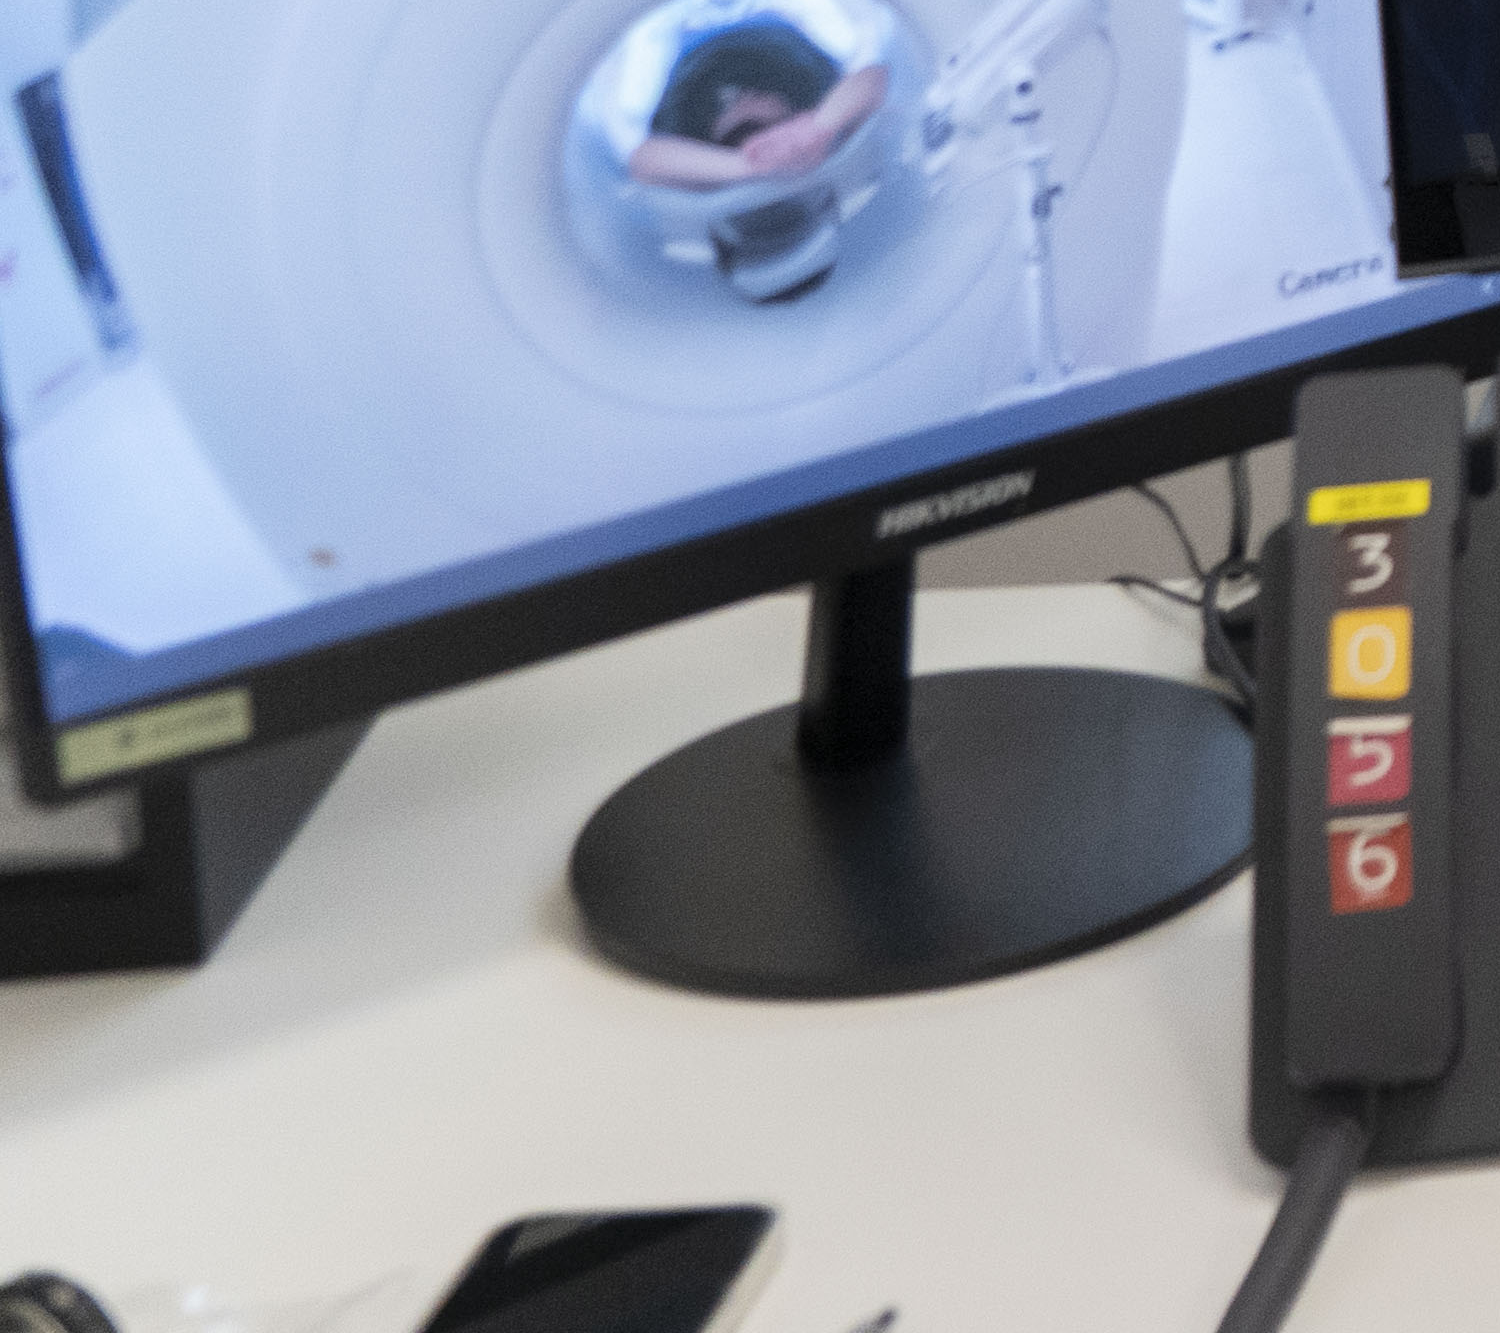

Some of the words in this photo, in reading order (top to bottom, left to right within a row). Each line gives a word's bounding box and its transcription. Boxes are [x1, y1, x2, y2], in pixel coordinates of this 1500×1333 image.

[1347, 532, 1394, 595] 3
[1346, 623, 1397, 686] 0
[1347, 731, 1395, 788] 5
[1346, 831, 1398, 900] 6
